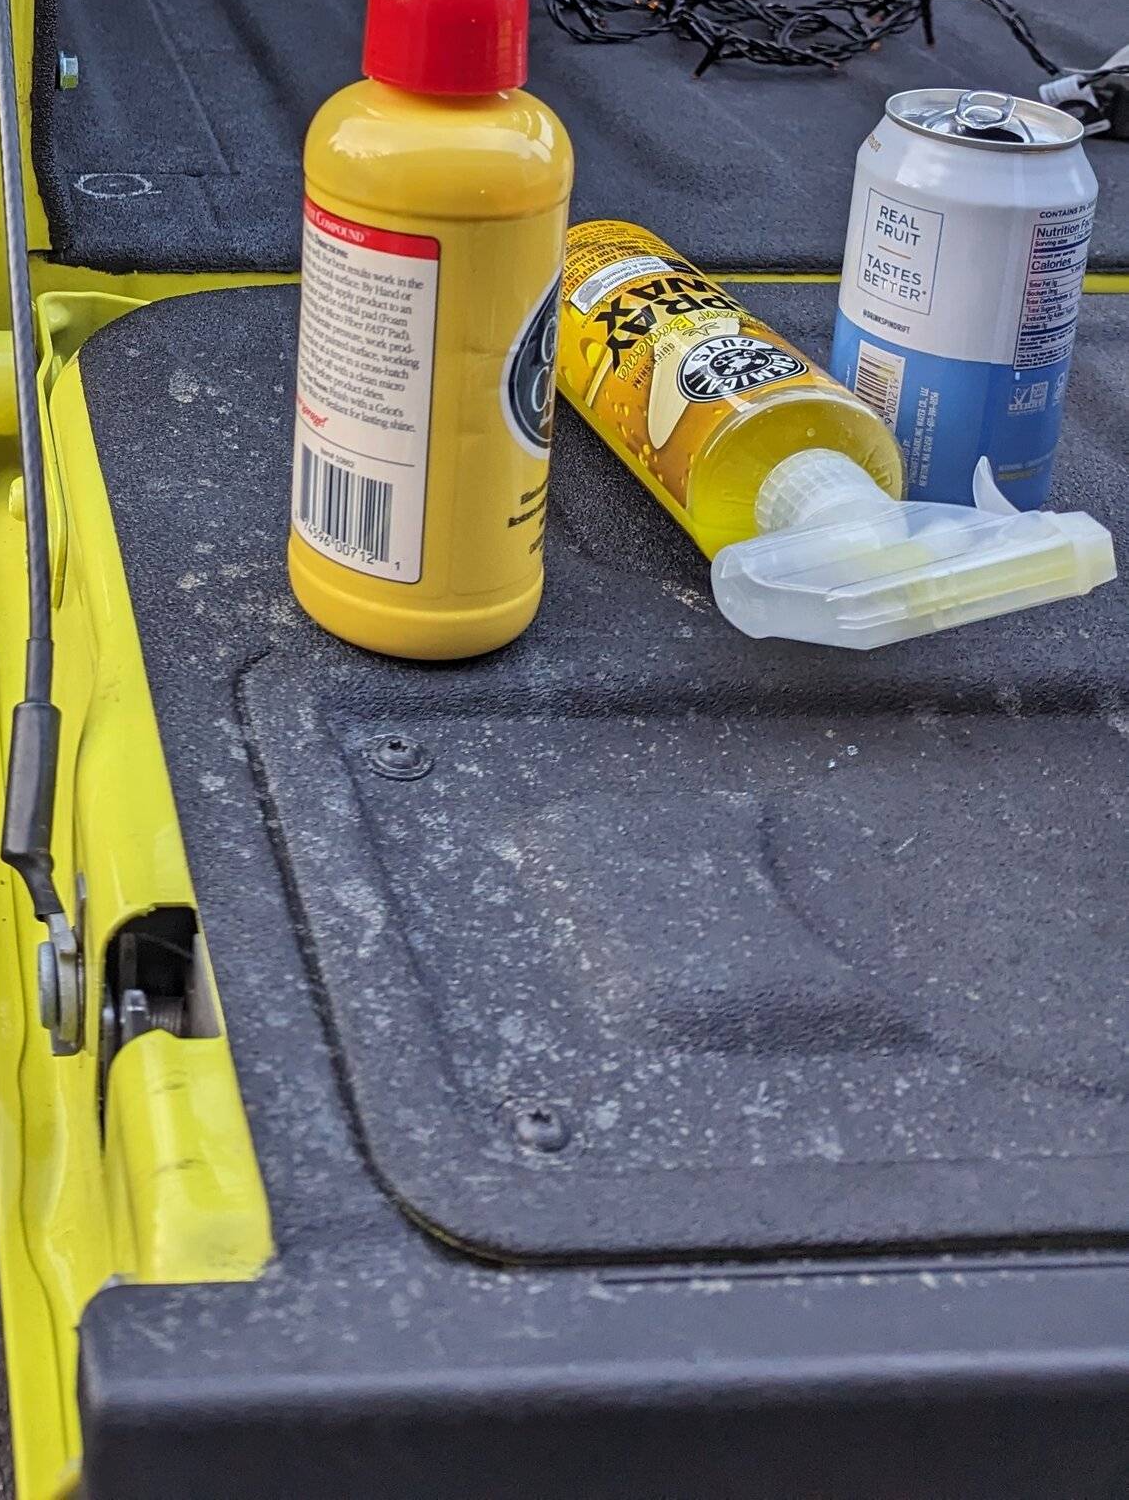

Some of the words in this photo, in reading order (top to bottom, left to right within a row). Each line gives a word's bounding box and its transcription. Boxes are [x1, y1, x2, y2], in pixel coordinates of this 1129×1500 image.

[879, 205, 920, 231] REAL
[1039, 207, 1078, 219] CONTAINS
[875, 220, 921, 246] FRUIT
[1036, 224, 1080, 238] Nutrition
[586, 241, 615, 256] GLOSS
[1034, 239, 1057, 247] Serving
[578, 255, 595, 269] ALL
[595, 248, 614, 260] FOR
[597, 253, 617, 266] AND
[867, 253, 922, 286] TASTES
[1031, 258, 1071, 271] Calories
[373, 273, 395, 285] work
[397, 275, 406, 287] in
[407, 276, 423, 289] the
[560, 263, 596, 299] REFLECTI
[600, 266, 631, 282] Carnauba
[602, 269, 640, 289] Brighteners
[361, 280, 373, 297] By
[374, 284, 399, 299] Hand
[401, 292, 411, 301] or
[389, 301, 399, 312] to
[400, 304, 412, 314] an
[592, 276, 715, 336] WAX
[360, 309, 377, 321] pad
[364, 321, 388, 336] FAST
[364, 336, 387, 349] work
[614, 314, 694, 381] Banana
[691, 338, 753, 361] GUYS
[688, 355, 795, 394] CHEMICAL
[916, 407, 926, 426] WATER
[922, 452, 930, 461] MA
[334, 540, 375, 565] 00712
[394, 561, 401, 571] 1
